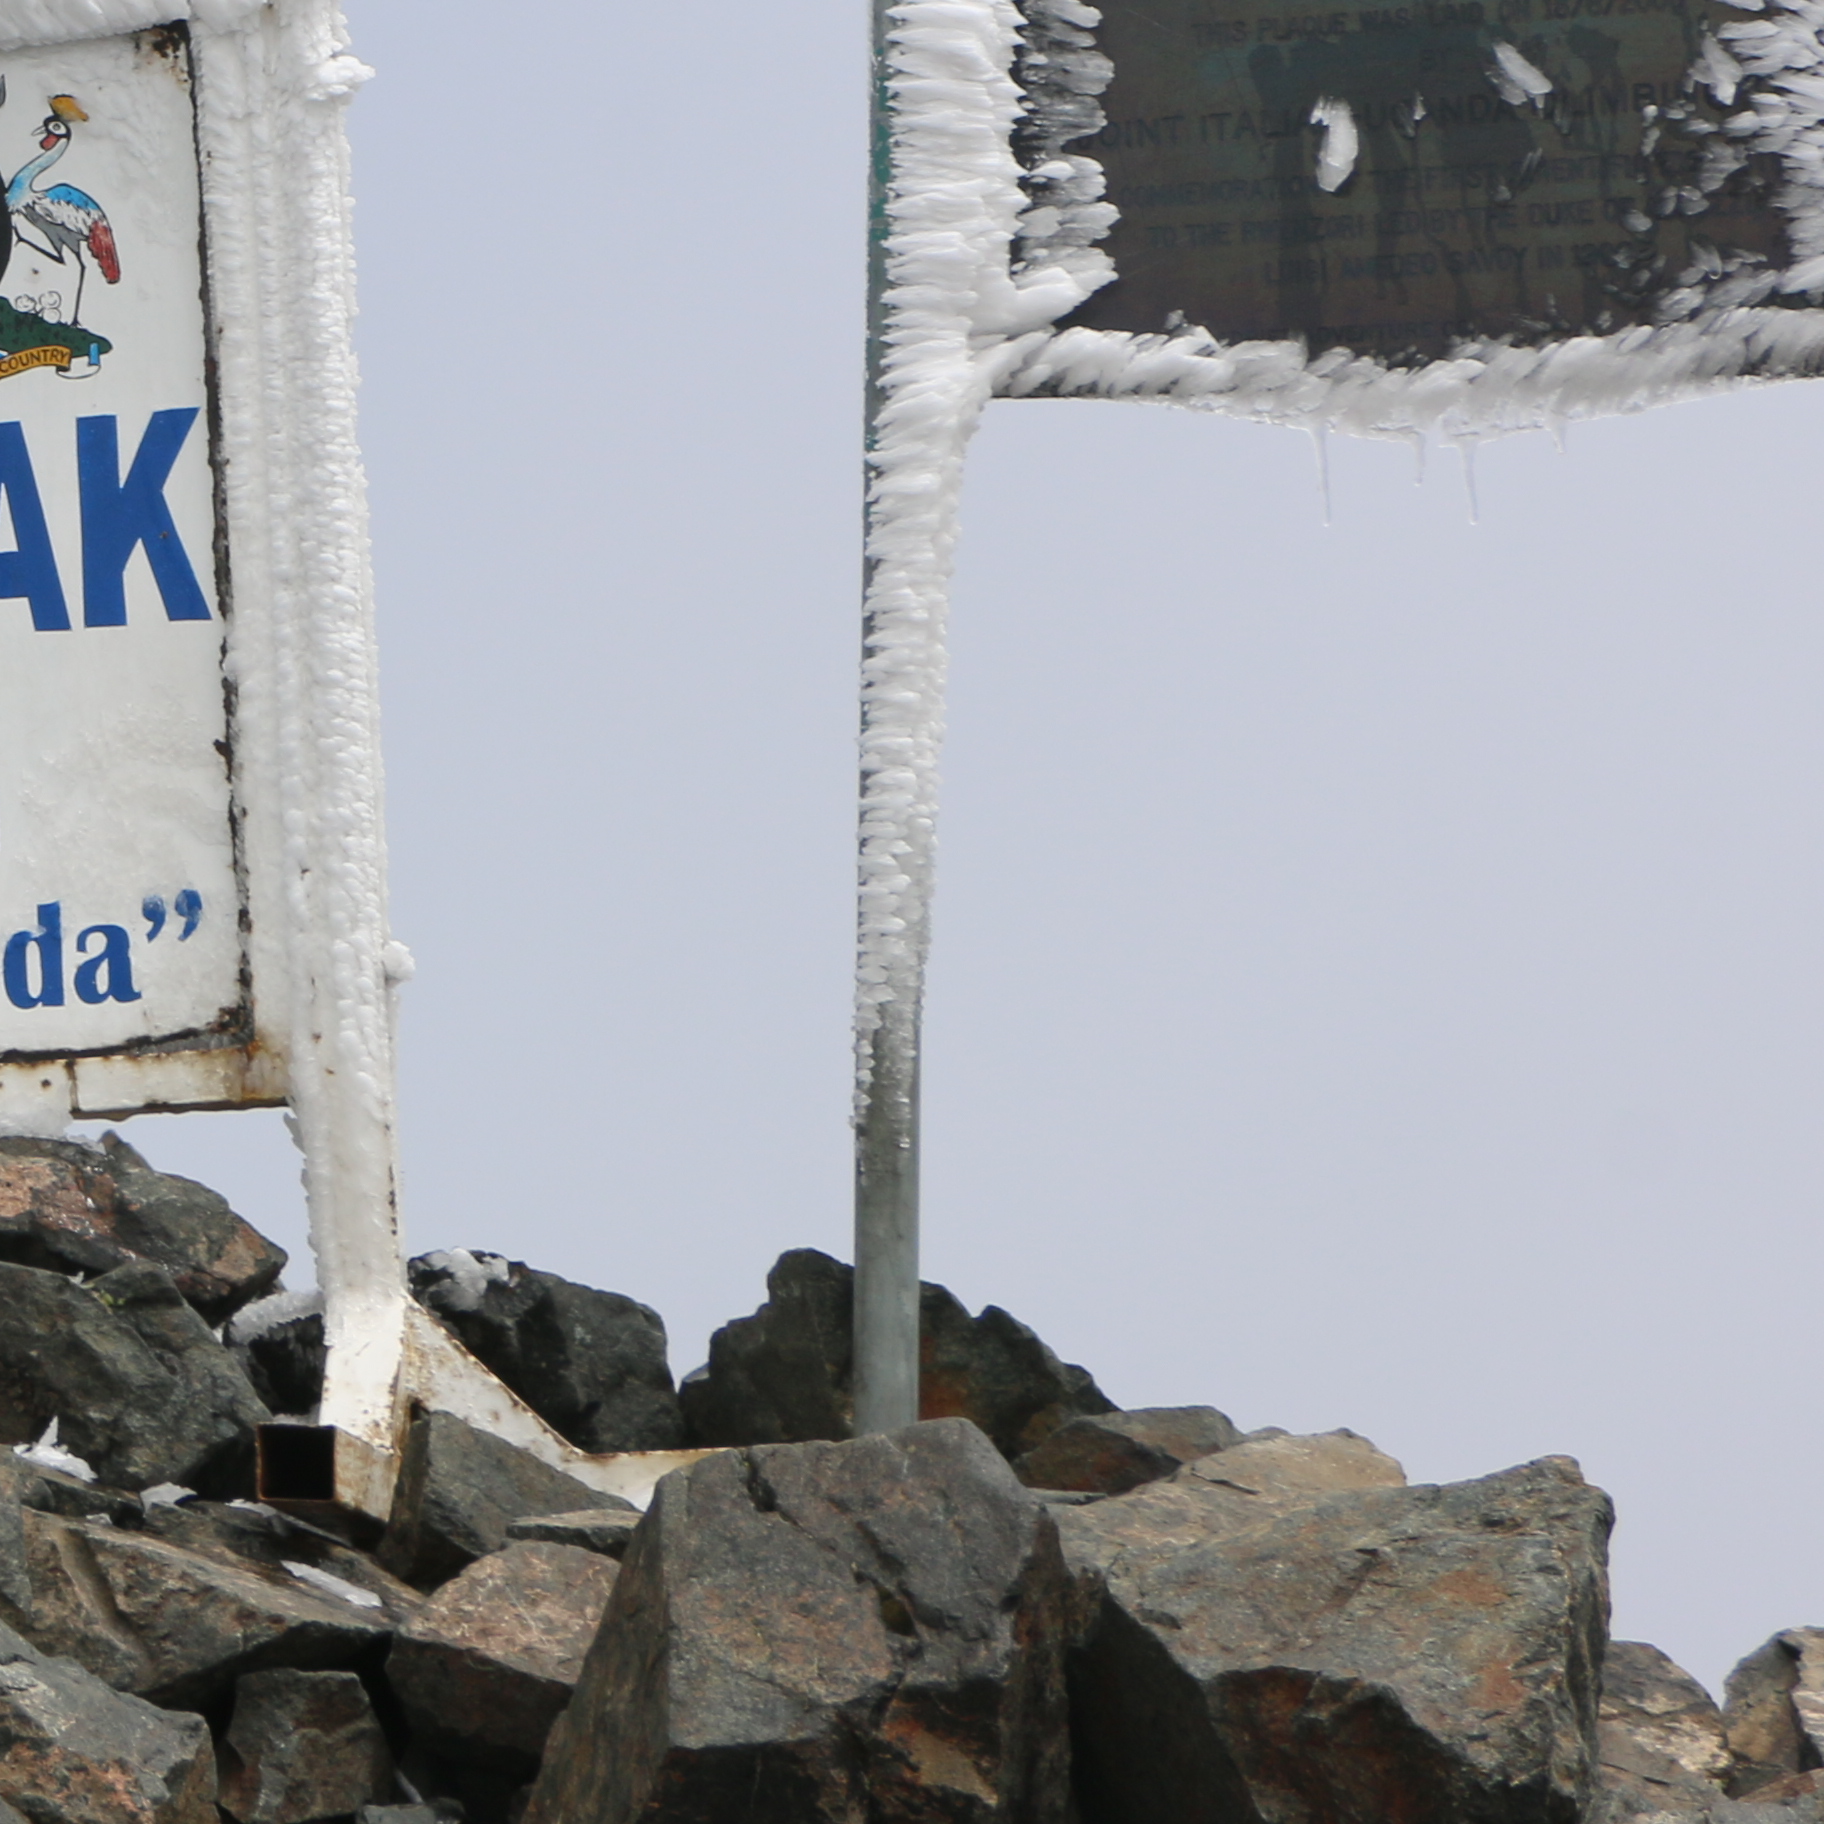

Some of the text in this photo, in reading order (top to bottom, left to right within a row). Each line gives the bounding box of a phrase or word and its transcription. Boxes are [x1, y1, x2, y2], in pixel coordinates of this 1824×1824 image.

[1191, 19, 1248, 47] THIS
[1255, 10, 1351, 43] PLAQUE
[1358, 7, 1412, 33] WAS
[1427, 1, 1484, 28] LAID
[1419, 47, 1450, 72] BY
[1146, 224, 1176, 248] TO
[1183, 220, 1232, 247] THE
[1375, 210, 1421, 236] LED
[1428, 208, 1465, 234] BY
[1528, 200, 1596, 228] DUKE
[1448, 245, 1528, 274] SAVOY
[1537, 243, 1563, 268] IN
